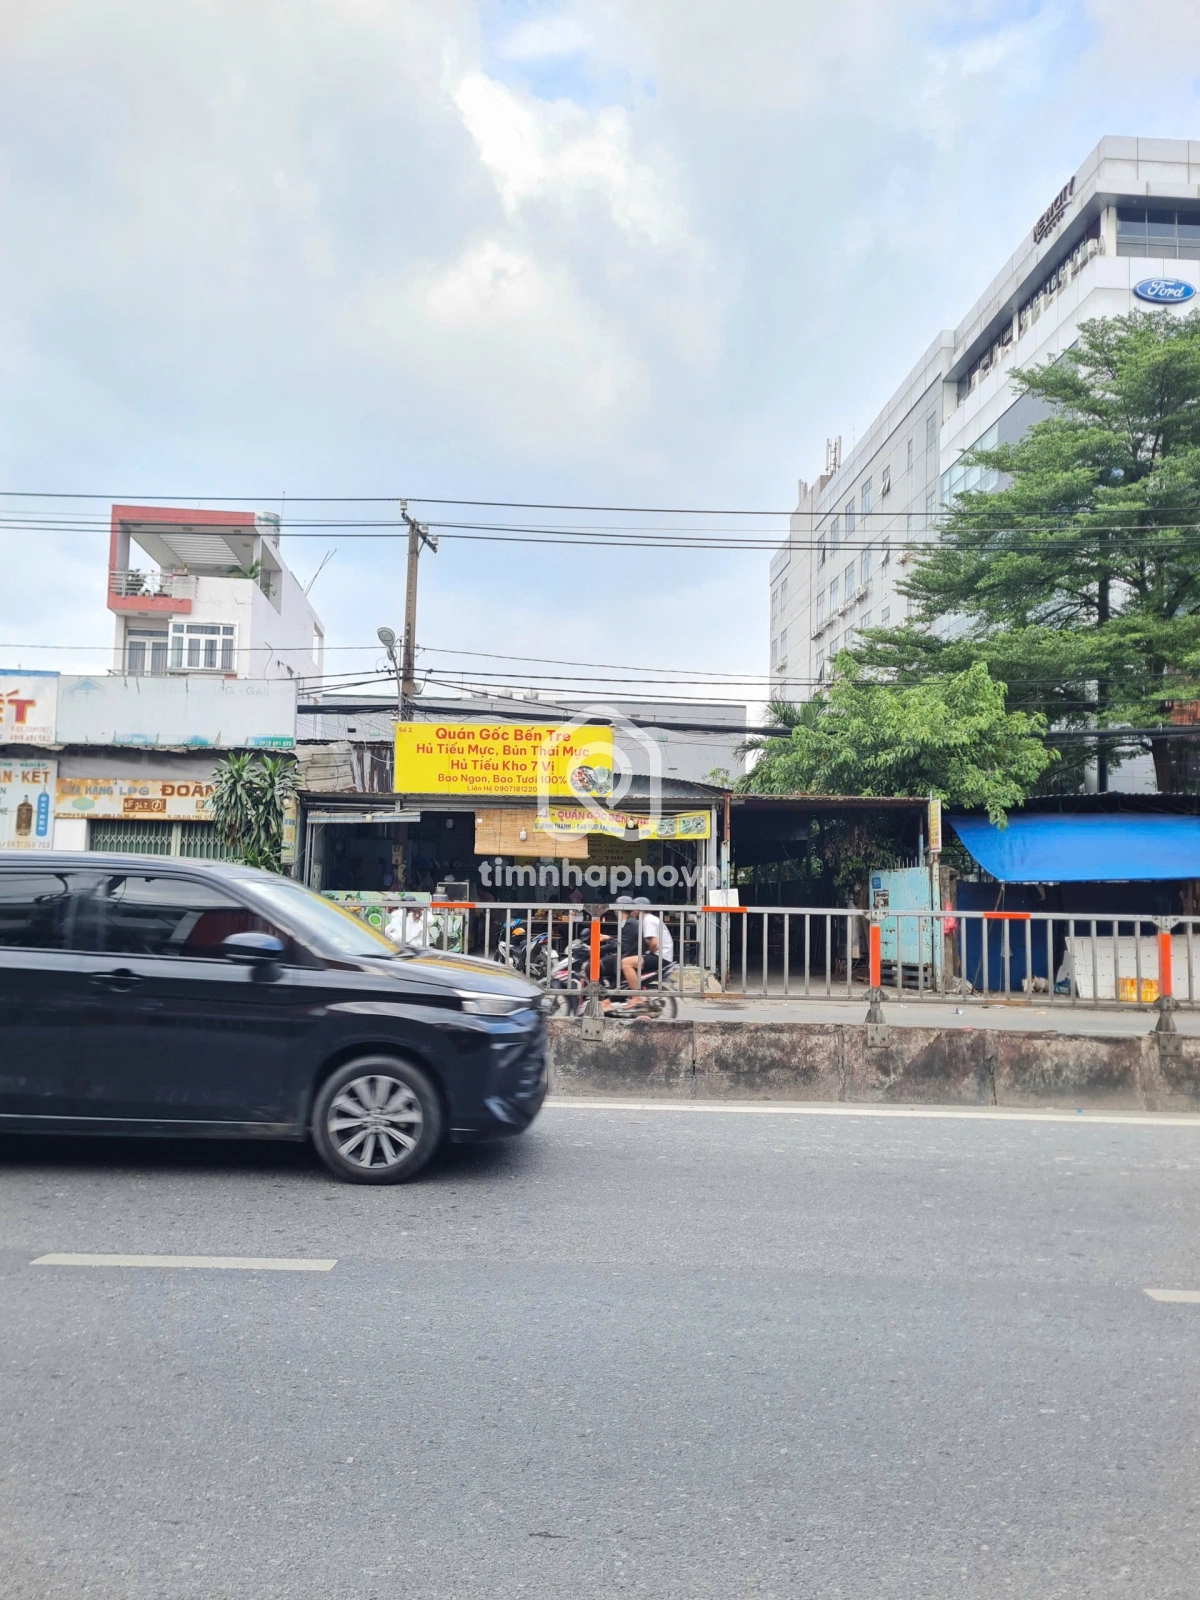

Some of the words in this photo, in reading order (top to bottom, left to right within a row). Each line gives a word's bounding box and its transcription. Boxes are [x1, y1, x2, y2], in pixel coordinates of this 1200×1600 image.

[1147, 280, 1185, 297] Ford
[435, 727, 475, 740] Quán
[479, 726, 510, 740] Gốc
[513, 727, 542, 741] Bến
[546, 729, 571, 742] Tre
[416, 742, 433, 754] Hủ
[437, 742, 464, 754] Tiếu
[467, 744, 499, 758] Mực,
[503, 744, 527, 755] Bún
[530, 745, 559, 756] Thái
[562, 746, 590, 759] Mực
[450, 758, 468, 770] Hủ
[471, 758, 499, 770] Tiếu
[502, 760, 527, 771] Kho
[530, 761, 538, 771] 7
[541, 761, 555, 774] Vị
[21, 767, 50, 784] KẾT
[438, 773, 458, 782] Bao
[460, 774, 490, 784] Ngon,
[493, 774, 513, 783] Bao
[516, 775, 538, 784] Tươi
[540, 775, 567, 784] 100%
[119, 785, 150, 796] LPG
[483, 785, 493, 793] Hệ
[494, 785, 538, 793] 0907181220
[38, 796, 47, 831] OXYGEN
[558, 809, 585, 821] QUÁN
[586, 809, 607, 821] GỐC
[609, 811, 628, 825] BẾN
